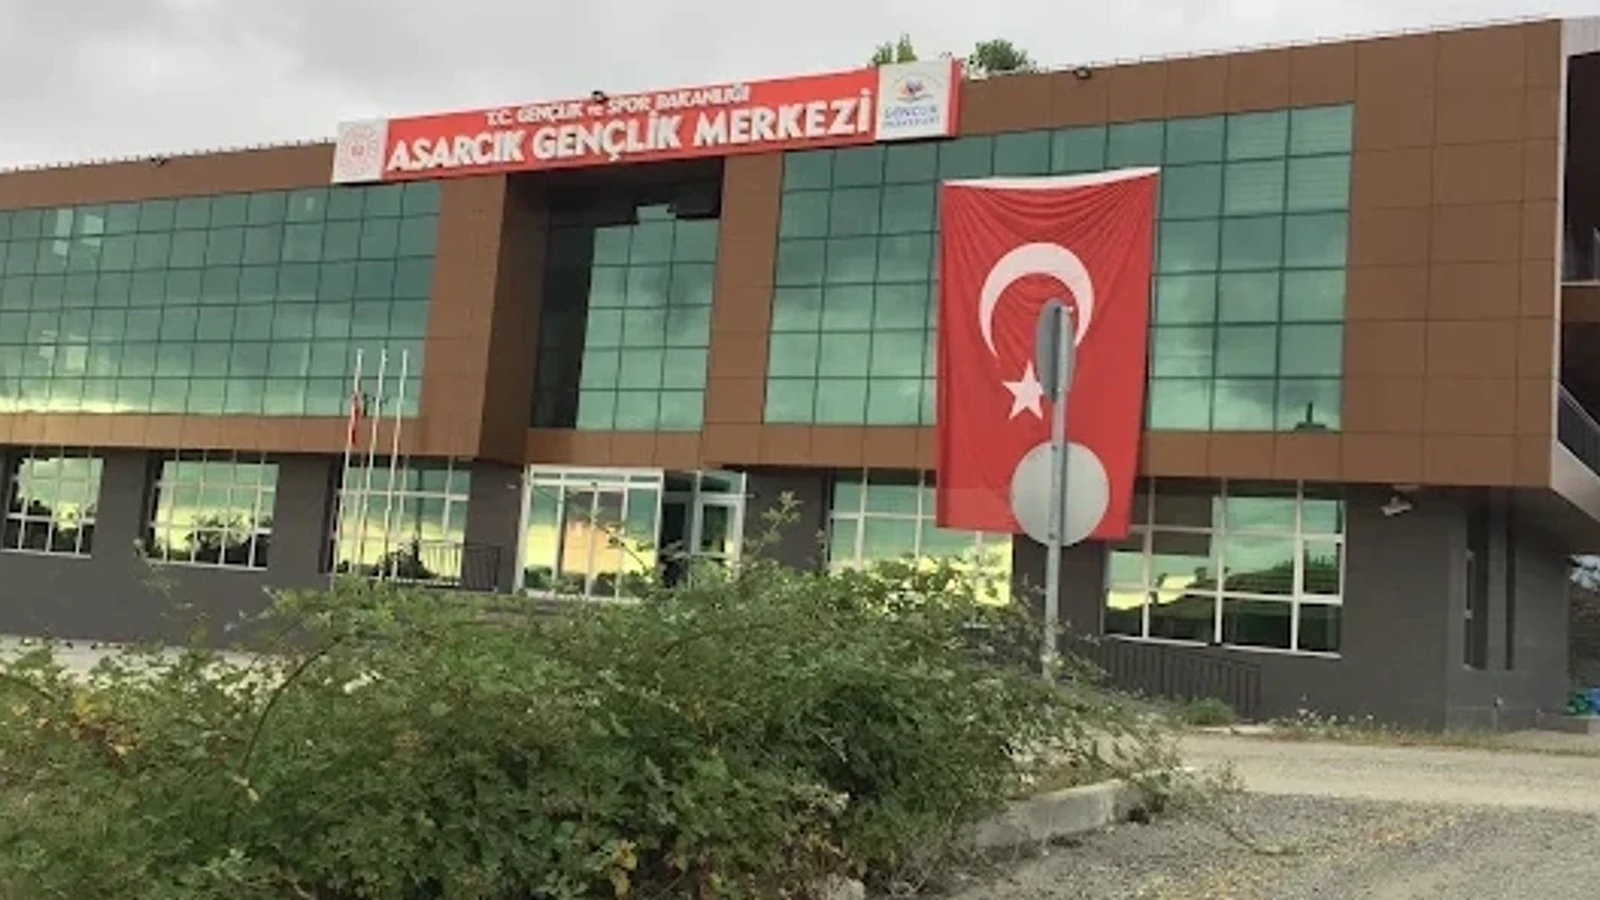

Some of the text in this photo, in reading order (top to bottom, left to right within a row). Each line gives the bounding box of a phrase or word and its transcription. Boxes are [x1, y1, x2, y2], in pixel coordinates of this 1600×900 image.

[387, 87, 873, 171] ASARCIK GENÇLİK MERKEZİ
[607, 94, 651, 115] SPOR
